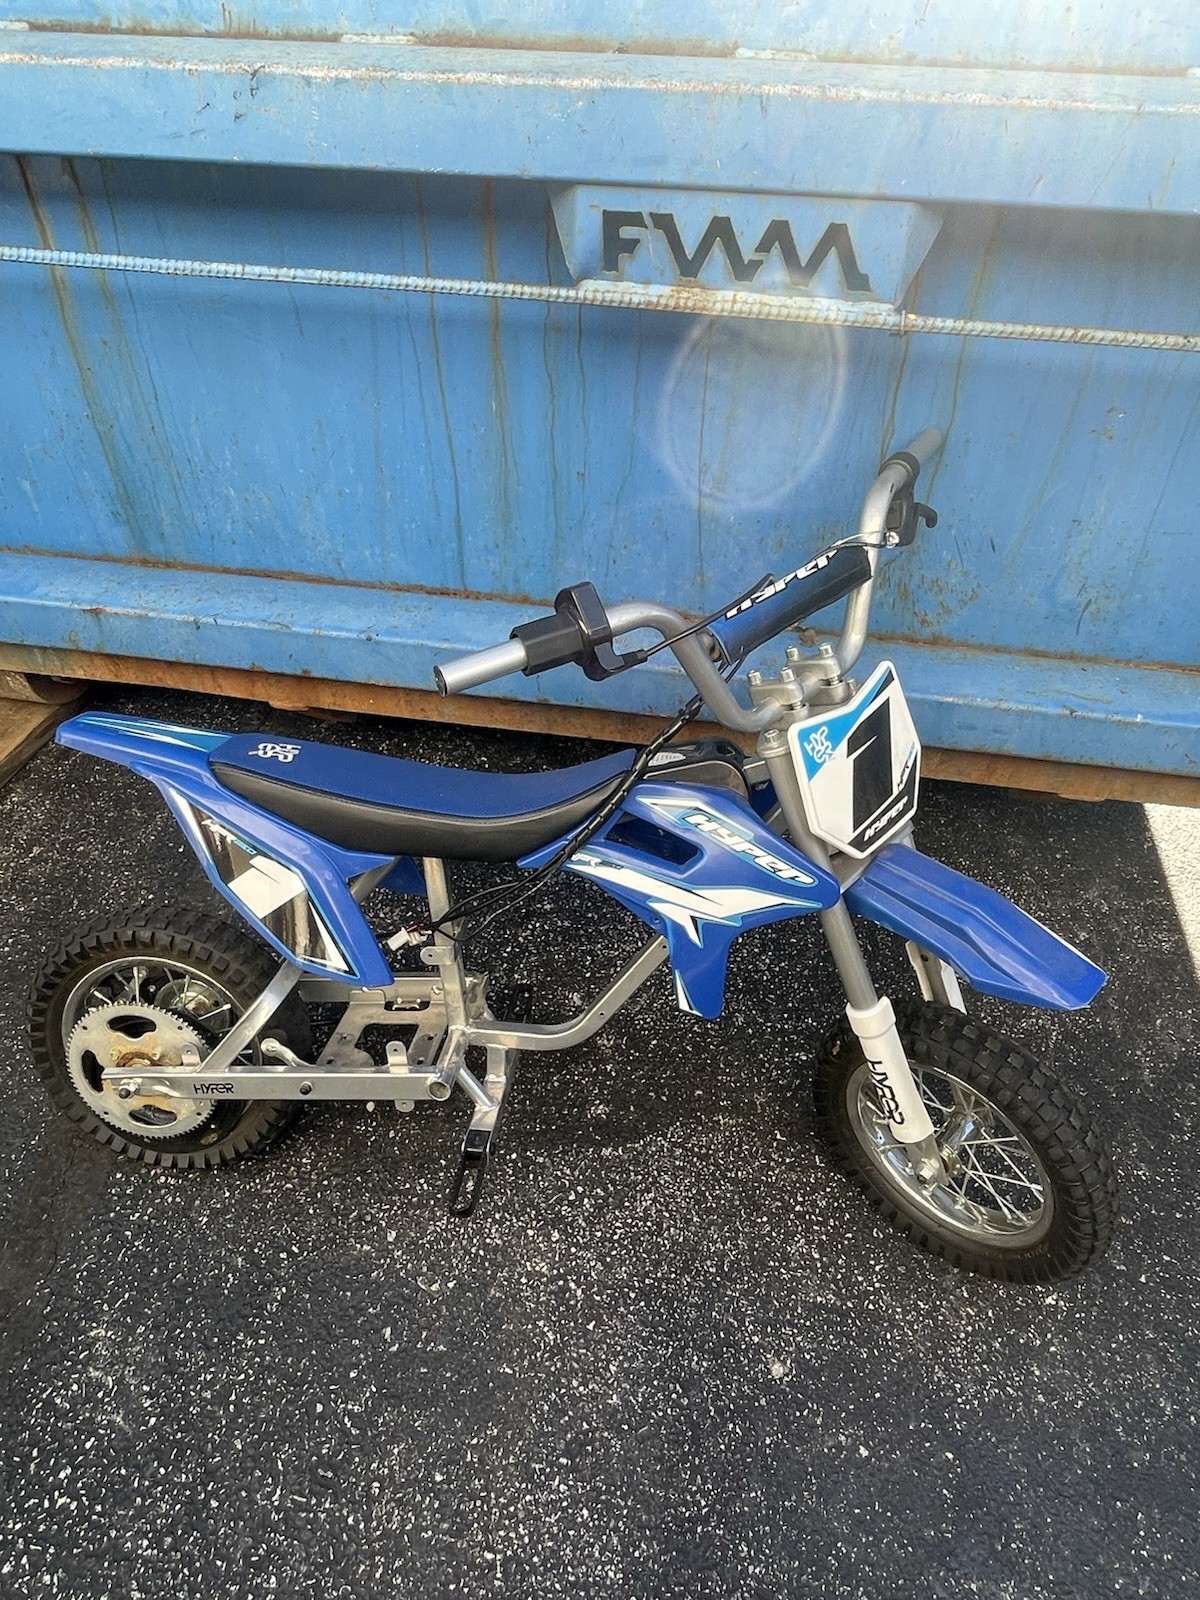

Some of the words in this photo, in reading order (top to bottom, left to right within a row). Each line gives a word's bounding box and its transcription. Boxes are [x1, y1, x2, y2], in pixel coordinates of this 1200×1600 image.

[602, 209, 871, 292] FWM
[846, 697, 894, 833] 1
[683, 813, 816, 884] HYPER
[864, 795, 909, 841] HYPER
